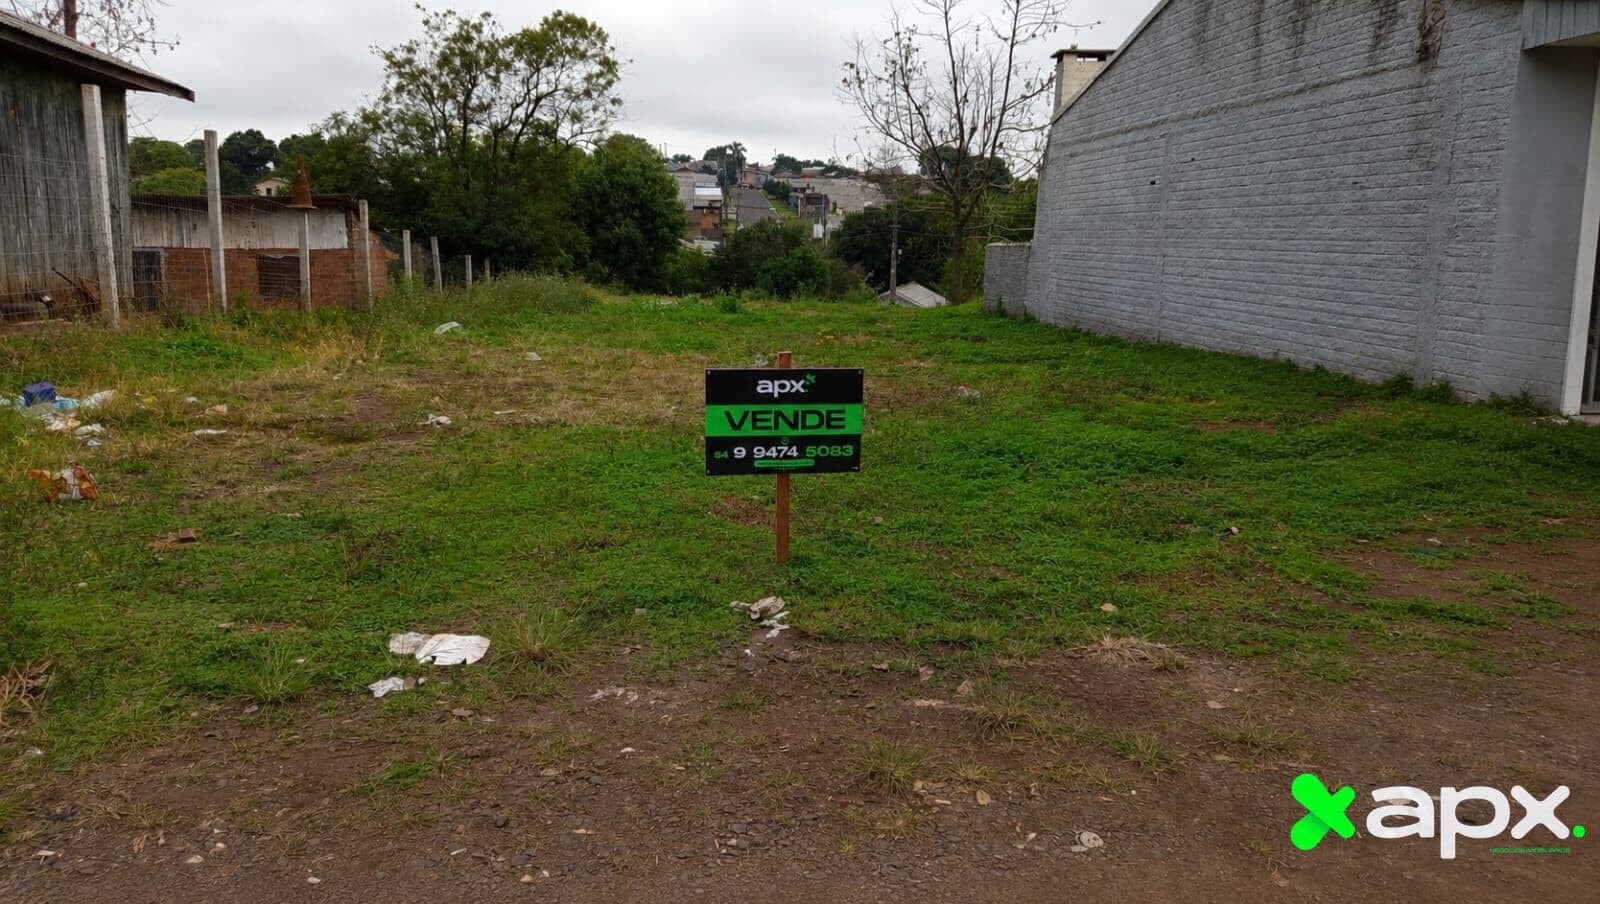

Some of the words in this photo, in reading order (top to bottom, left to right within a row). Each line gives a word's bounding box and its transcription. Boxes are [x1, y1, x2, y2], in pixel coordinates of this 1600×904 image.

[723, 409, 846, 431] VENDE
[713, 450, 729, 459] 54
[733, 446, 746, 459] 9
[753, 445, 799, 459] 9474
[805, 444, 854, 457] 5083
